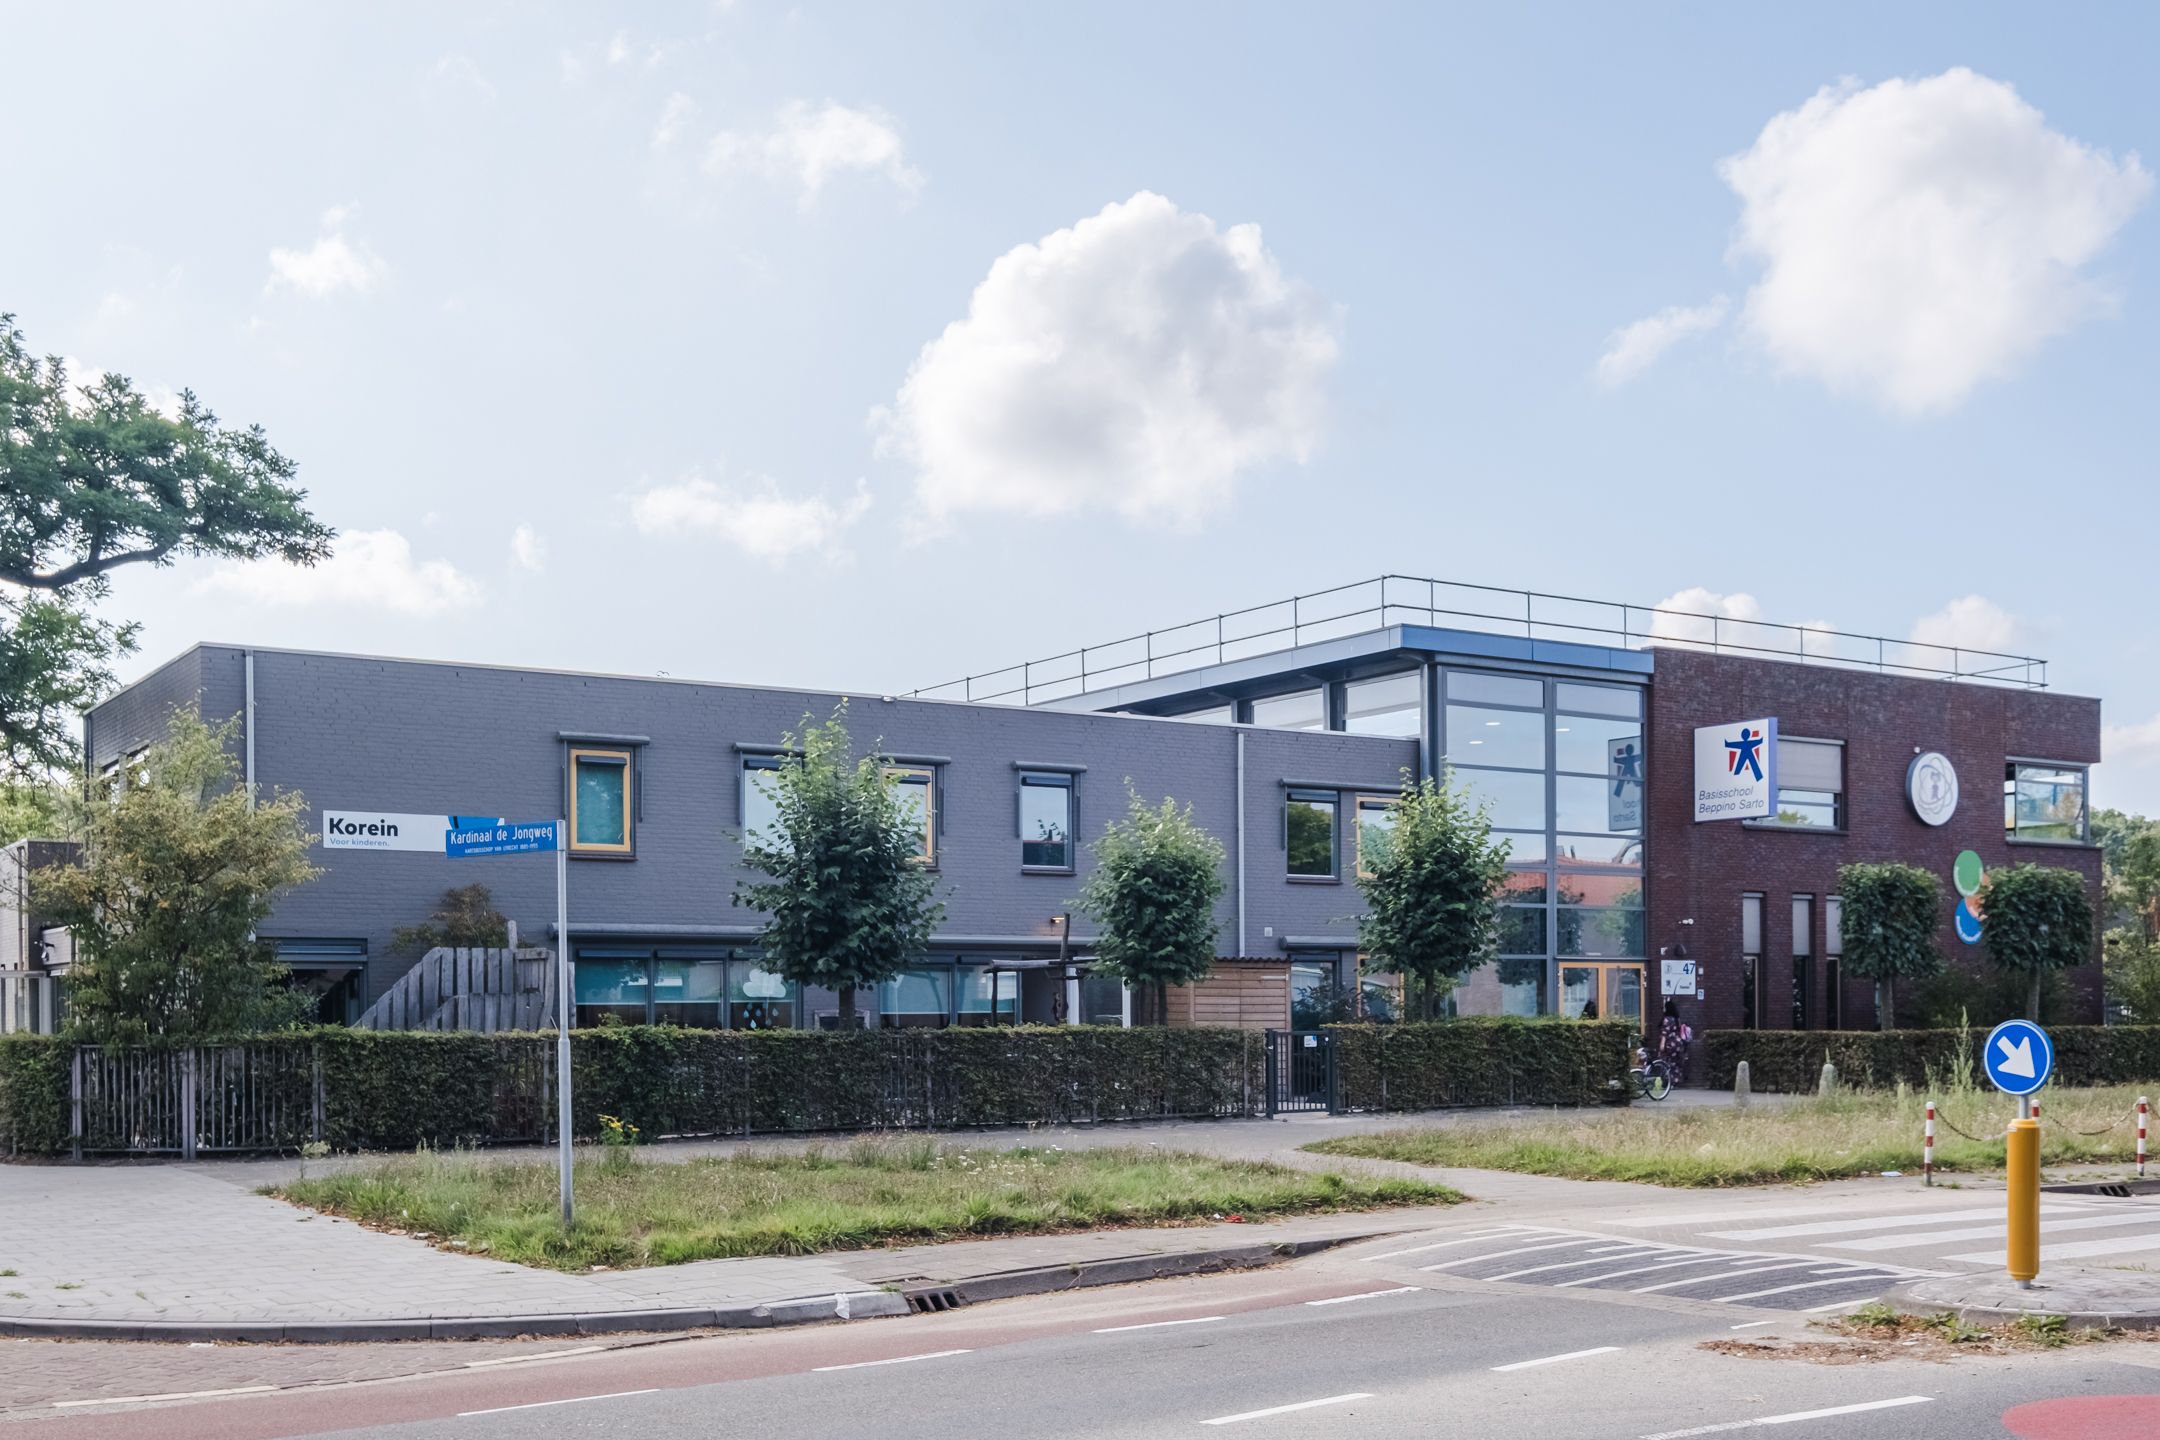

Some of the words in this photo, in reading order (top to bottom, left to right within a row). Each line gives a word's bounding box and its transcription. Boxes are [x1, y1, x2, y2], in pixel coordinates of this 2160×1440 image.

[1699, 785, 1754, 800] Basisschool
[1698, 802, 1736, 814] Beppino
[1739, 799, 1764, 810] Sarto
[329, 817, 399, 837] Korein
[351, 838, 390, 847] kinderen.
[450, 829, 493, 845] Kardinaal
[496, 828, 508, 841] de
[512, 826, 553, 843] Jongweg
[1683, 963, 1696, 975] 47
